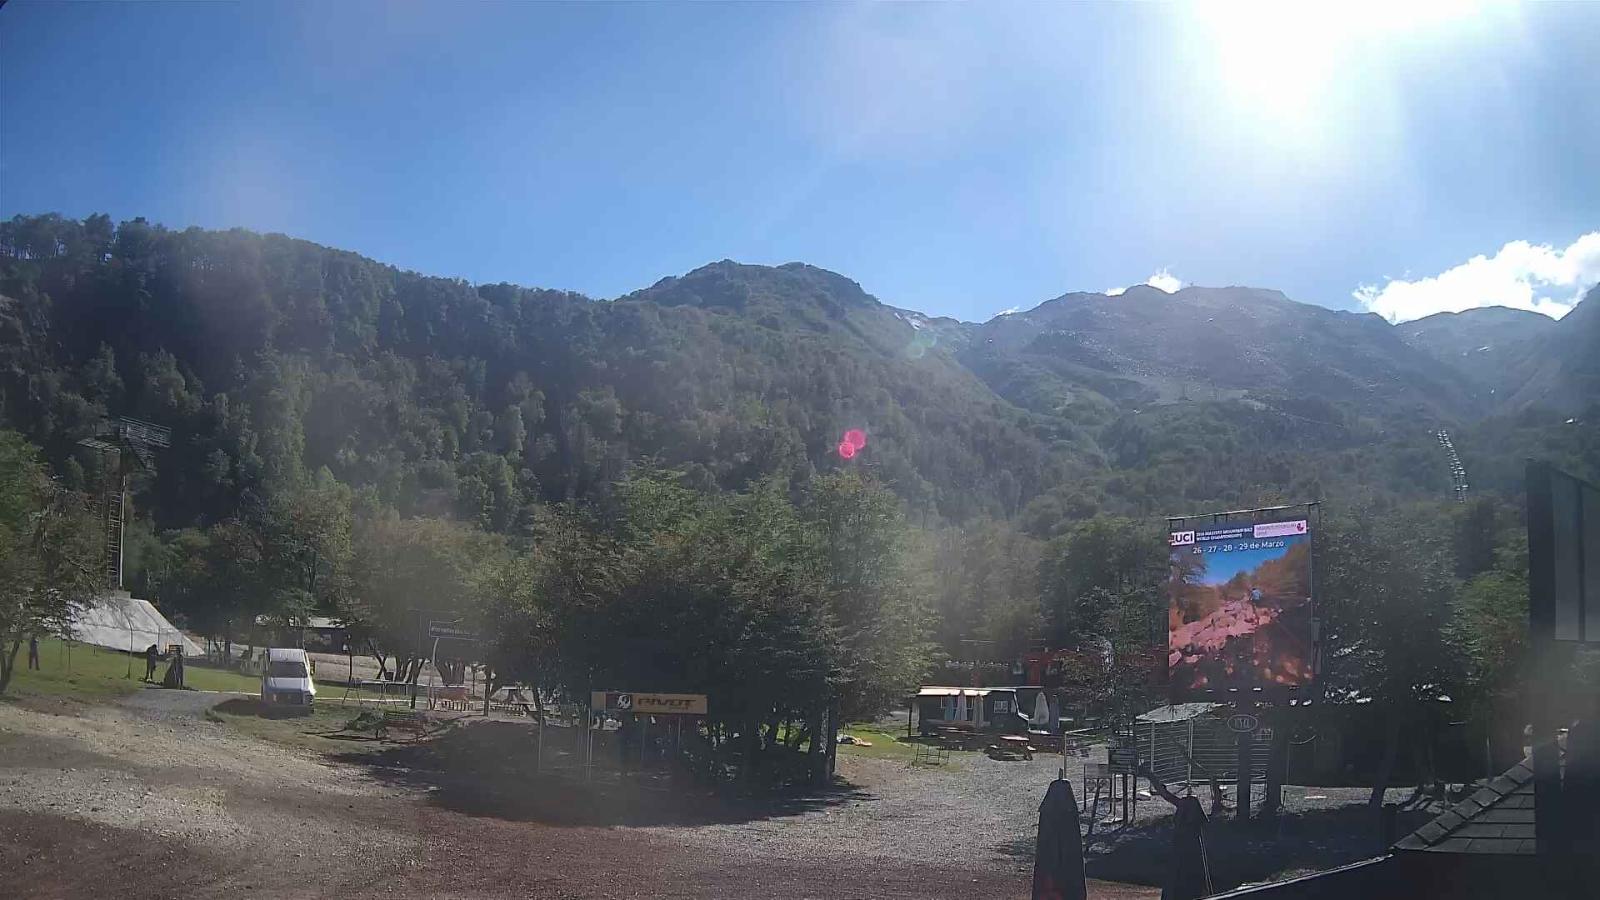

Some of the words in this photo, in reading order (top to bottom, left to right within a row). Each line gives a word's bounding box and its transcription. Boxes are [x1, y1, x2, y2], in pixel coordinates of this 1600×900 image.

[1175, 533, 1193, 543] UCI
[1208, 545, 1217, 553] 27
[1223, 544, 1233, 552] 28
[1239, 542, 1248, 550] 29
[1261, 540, 1285, 548] Marzo
